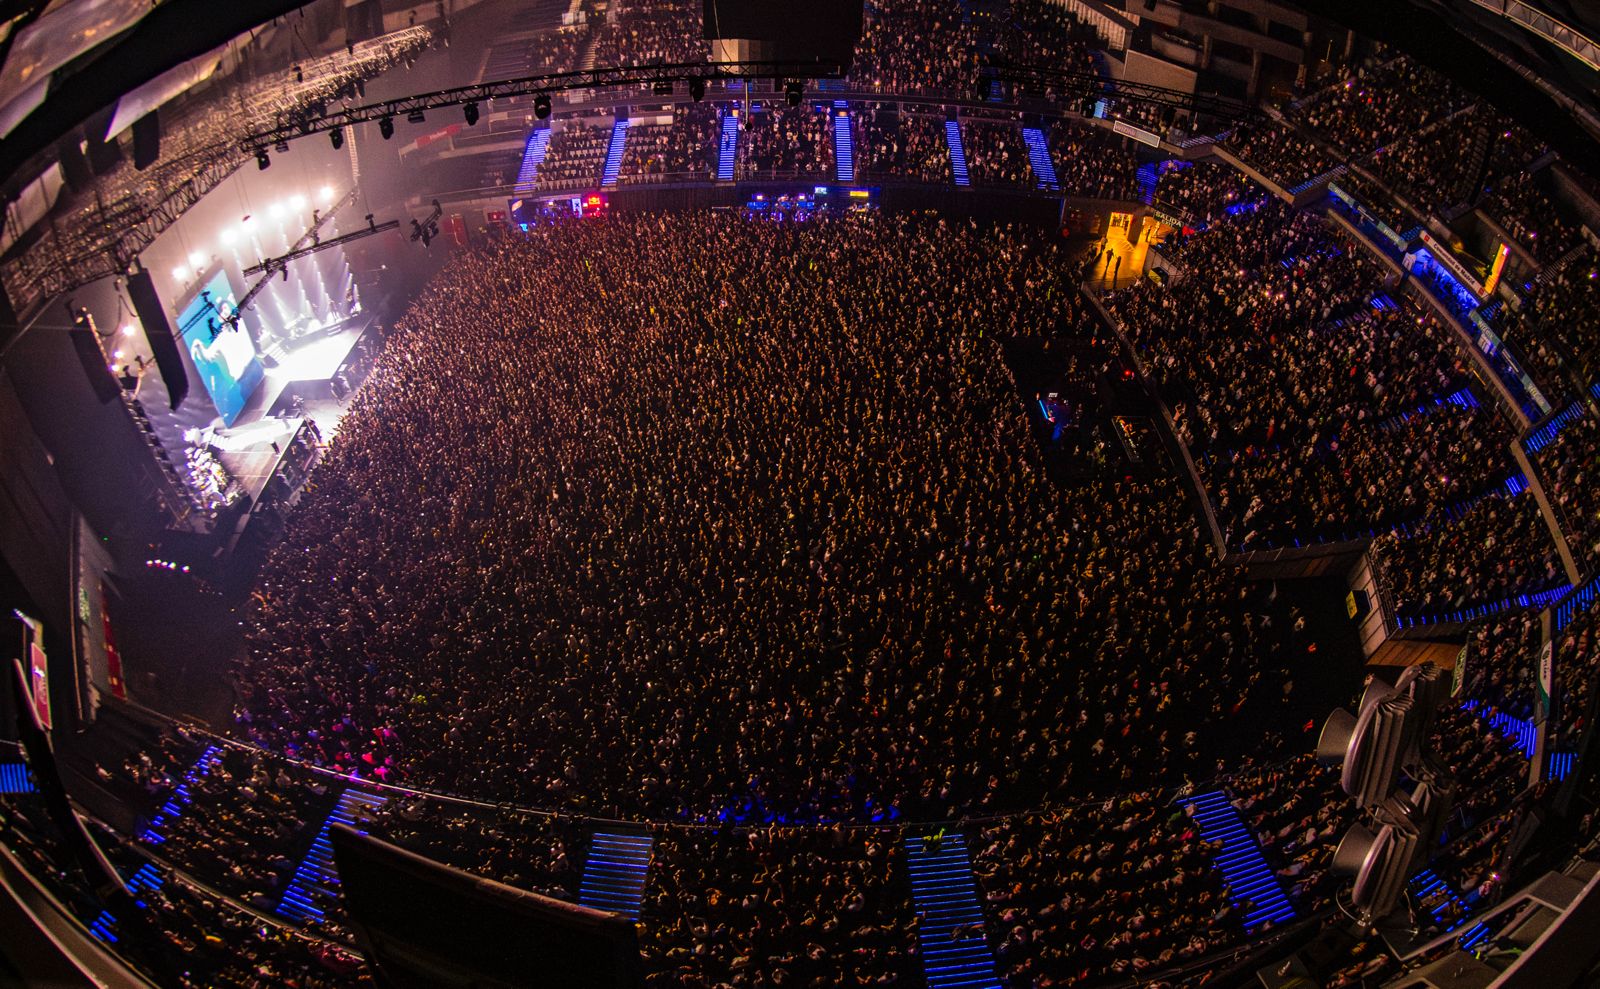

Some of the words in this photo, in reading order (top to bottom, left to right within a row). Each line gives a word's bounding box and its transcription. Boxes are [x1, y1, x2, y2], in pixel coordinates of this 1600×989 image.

[1155, 211, 1182, 227] SALIDA
[1433, 243, 1456, 266] Comunidad
[1460, 269, 1475, 285] Madrid
